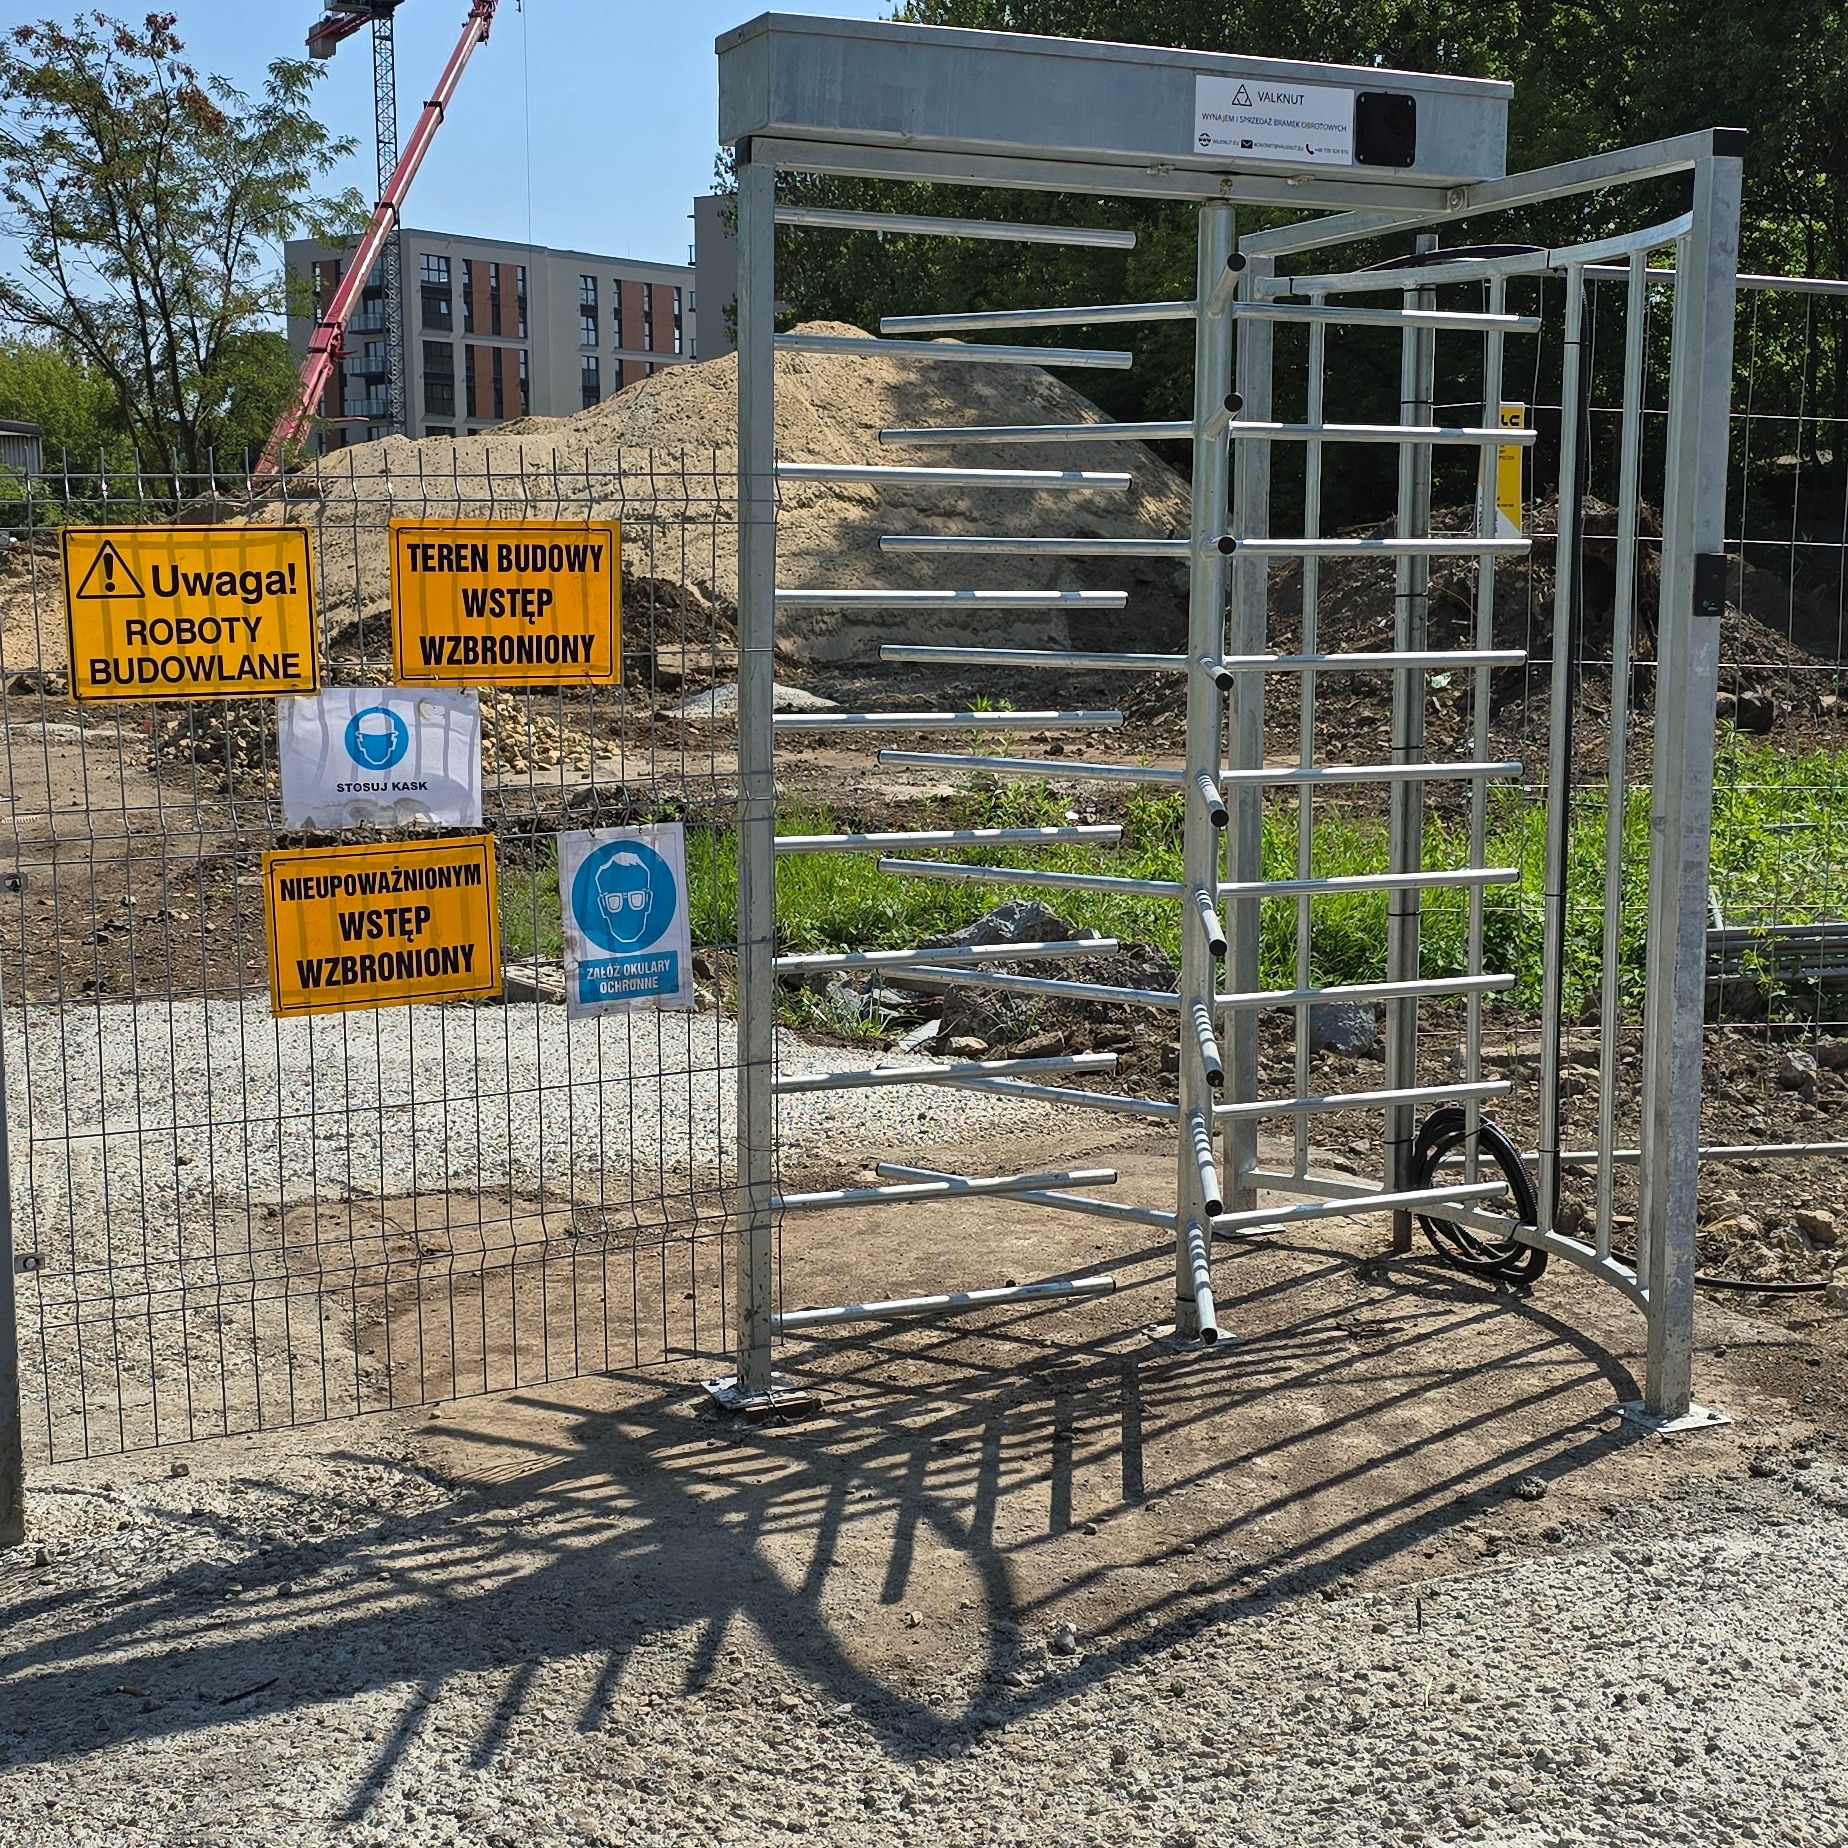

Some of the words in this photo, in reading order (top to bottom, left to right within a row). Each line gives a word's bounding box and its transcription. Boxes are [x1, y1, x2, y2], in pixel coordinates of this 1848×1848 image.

[1258, 90, 1305, 106] VALKNUT
[1202, 113, 1234, 122] WYNAJEM
[1240, 116, 1272, 126] SPRZEDAŻ
[1274, 119, 1300, 128] BRAMEK
[1301, 121, 1347, 132] OBROTOWYCH
[407, 544, 489, 573] TEREN
[497, 543, 604, 573] BUDOWY
[151, 563, 296, 605] Uwaga!
[462, 587, 553, 625] WSTĘP
[126, 617, 262, 646] ROBOTY
[420, 635, 595, 666] WZBRONIONY
[90, 653, 301, 686] BUDOWLANE
[336, 782, 387, 793] STOSUJ
[391, 781, 428, 792] KASK
[280, 864, 481, 901] NIEUPOWAŻNIONYM
[338, 905, 431, 943] WSTĘP
[296, 943, 475, 989] WZBRONIONY
[586, 962, 619, 980] ZAŁÓŻ
[621, 958, 670, 977] OKULARY
[599, 976, 659, 993] OCHRONNE
